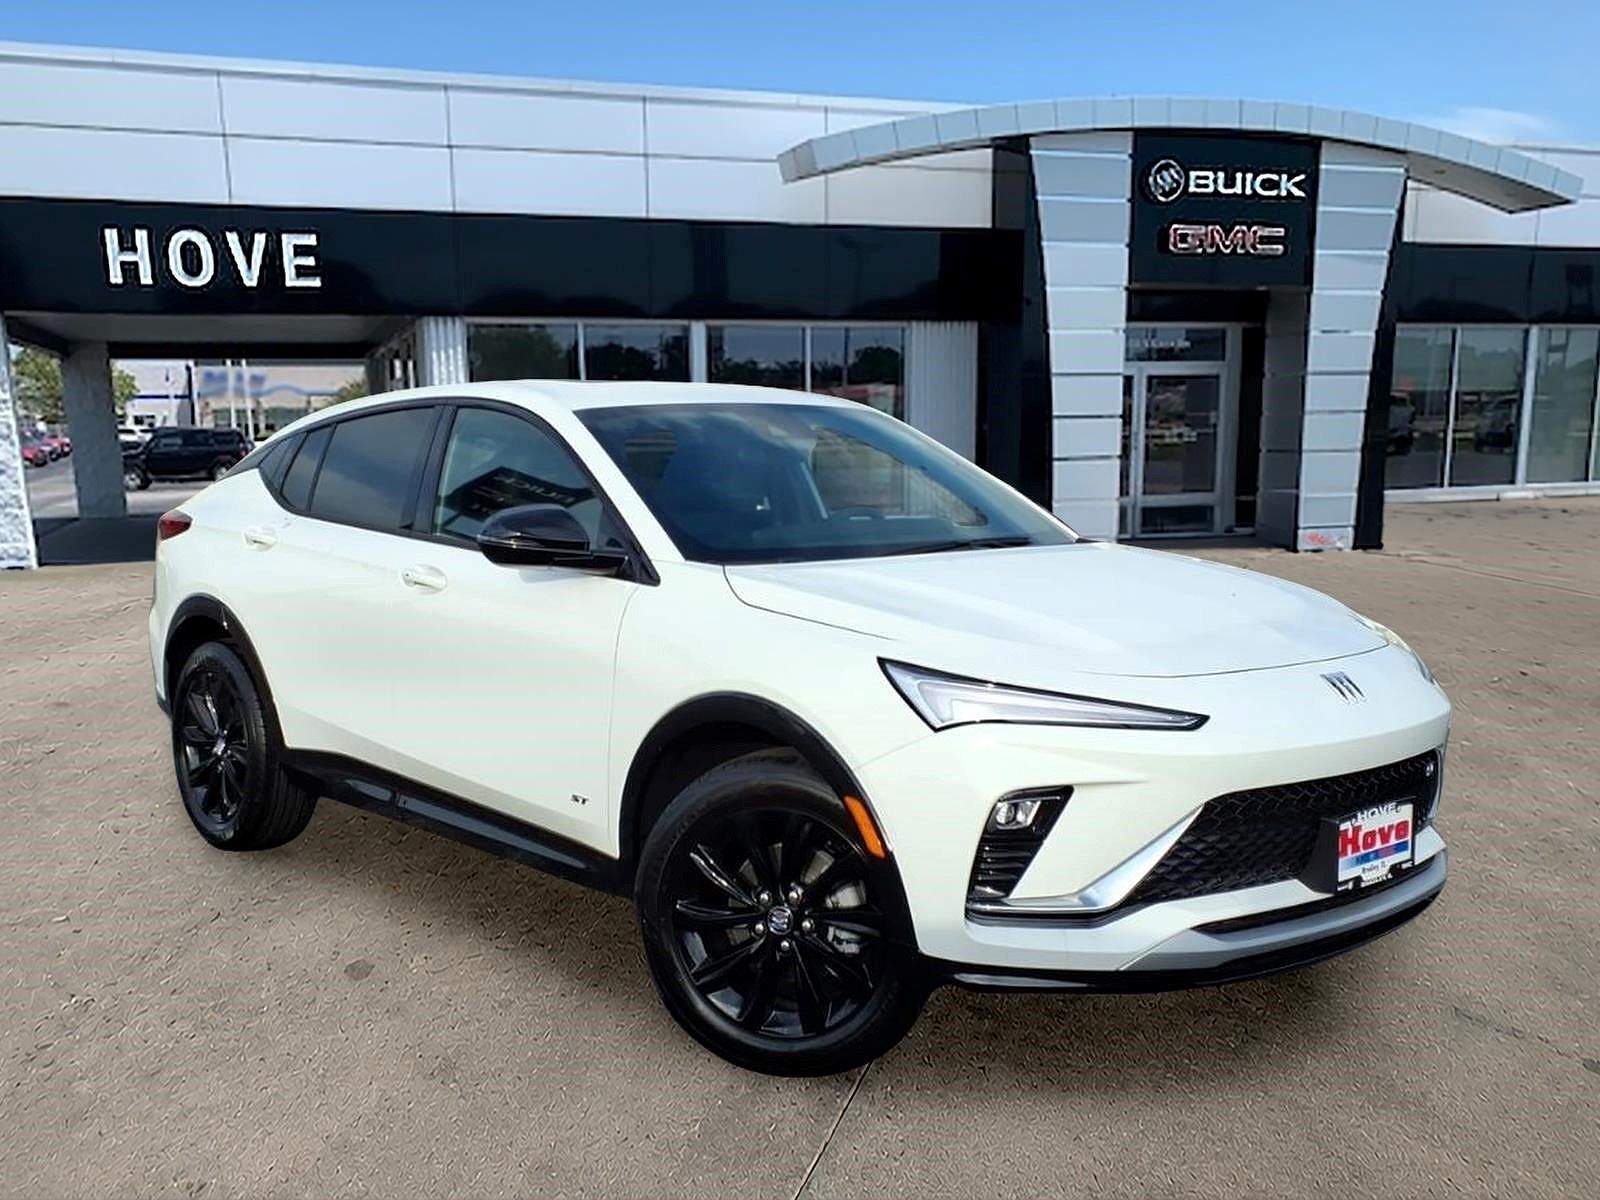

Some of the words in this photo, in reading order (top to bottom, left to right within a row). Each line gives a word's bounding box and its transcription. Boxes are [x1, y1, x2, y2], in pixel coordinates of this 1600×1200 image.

[1188, 170, 1306, 198] BUICK
[1168, 224, 1286, 255] GMC
[104, 227, 322, 288] HOVE
[1356, 802, 1397, 821] HOVE
[1339, 820, 1410, 858] Hove
